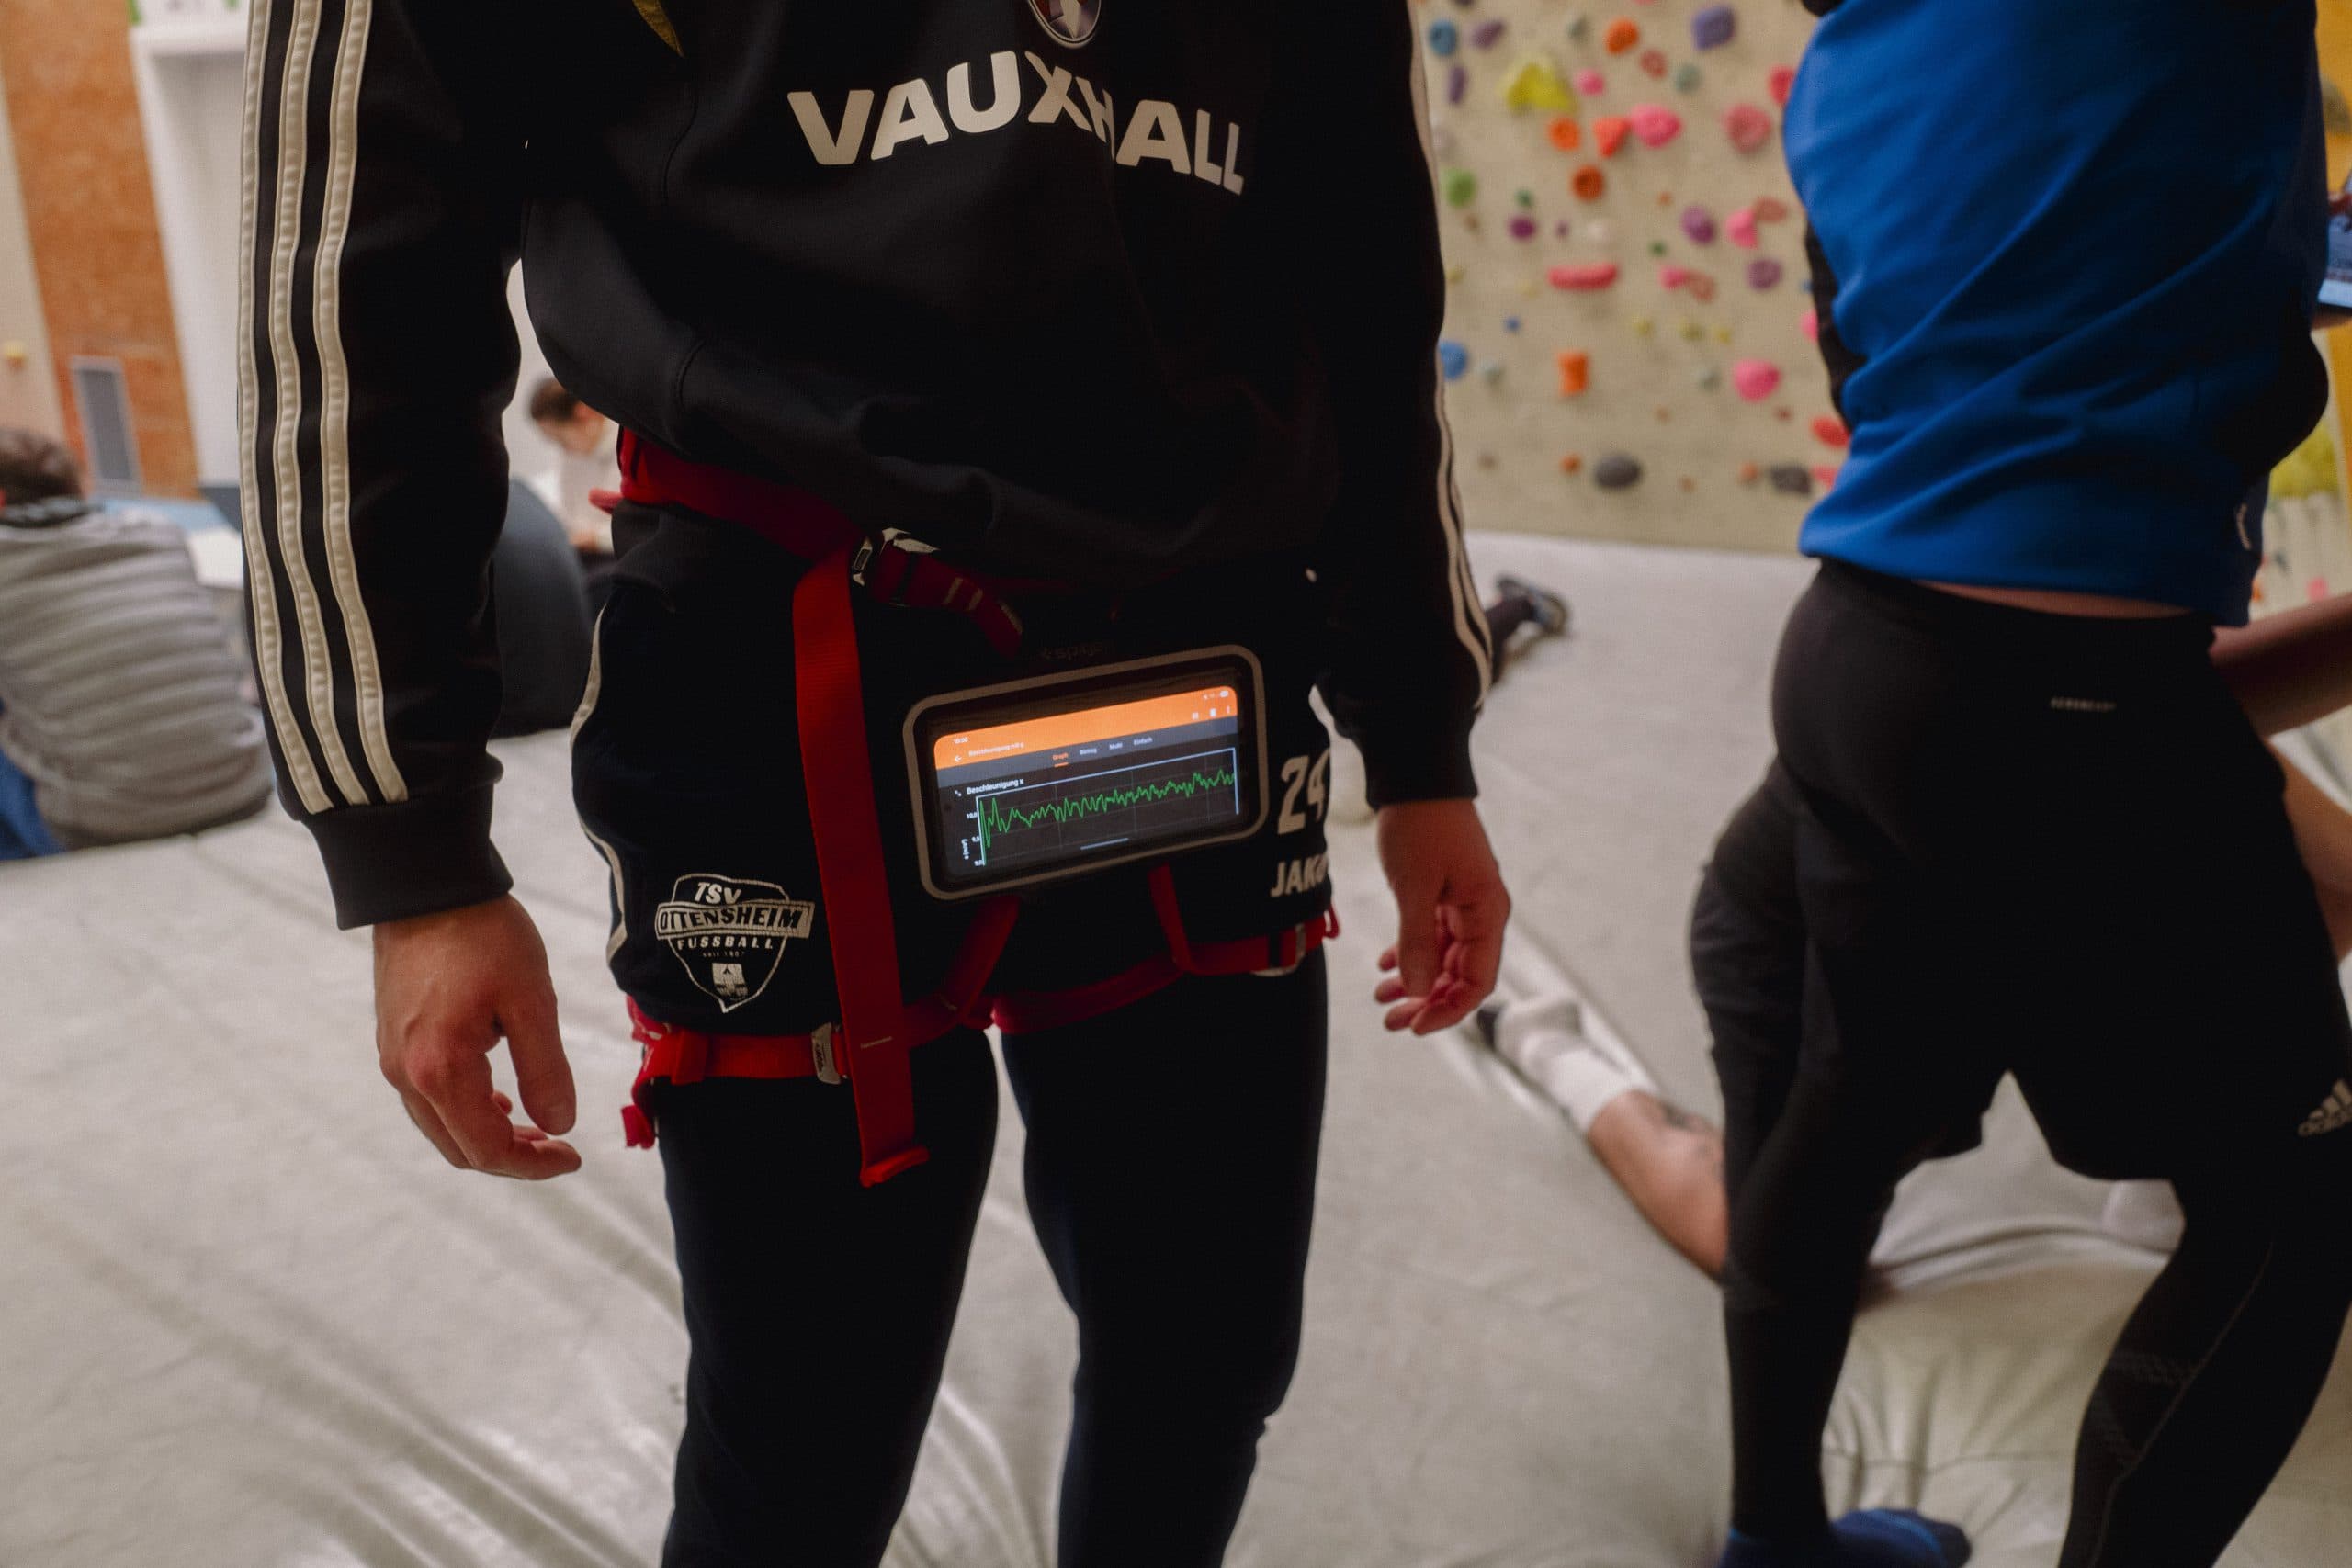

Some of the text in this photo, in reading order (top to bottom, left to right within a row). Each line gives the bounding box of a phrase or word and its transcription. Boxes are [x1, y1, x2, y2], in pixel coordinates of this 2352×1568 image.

[787, 51, 1243, 196] VAUXHALL
[966, 779, 1019, 795] Beschleunigung
[1277, 748, 1330, 835] 24
[694, 881, 742, 906] TSV
[659, 906, 804, 931] OTTENSHEIM
[677, 936, 774, 951] FUSSBALL
